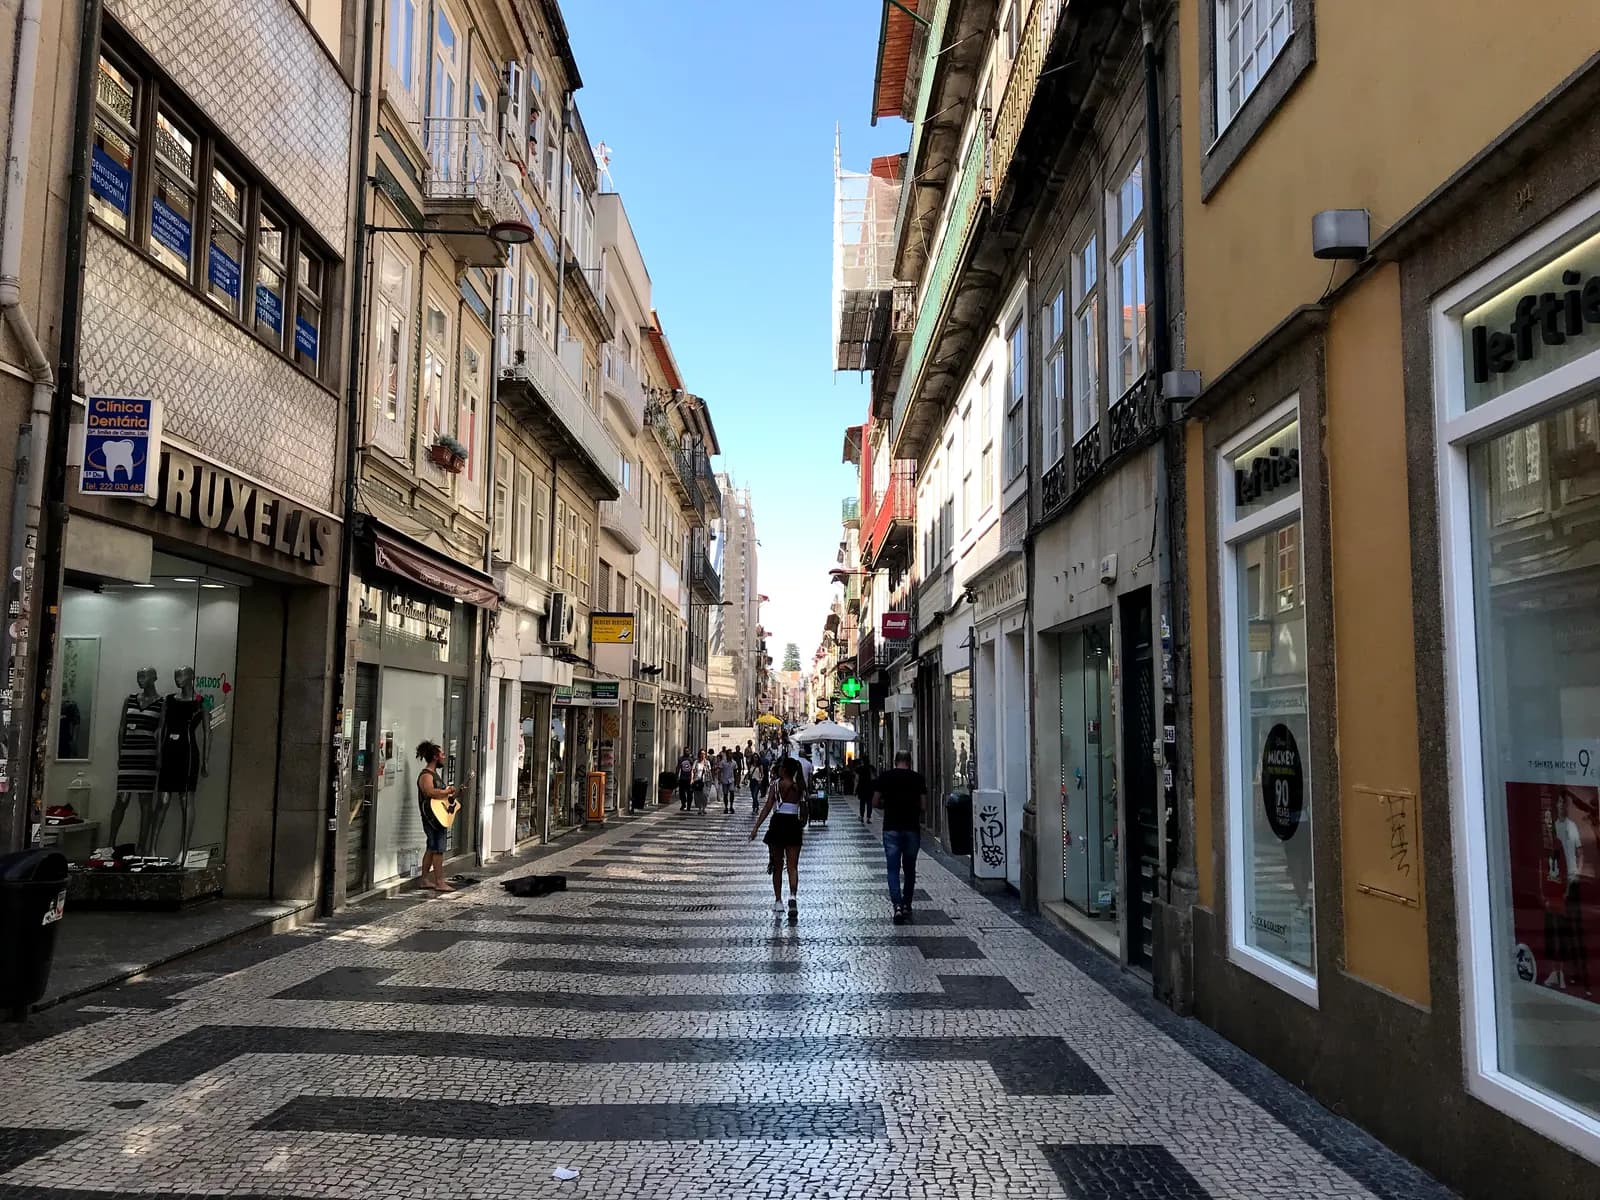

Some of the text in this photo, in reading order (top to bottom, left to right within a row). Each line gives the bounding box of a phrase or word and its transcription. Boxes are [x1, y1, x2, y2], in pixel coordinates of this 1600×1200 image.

[95, 400, 144, 413] Clínica
[89, 415, 148, 428] Dentária
[152, 450, 333, 567] RUXELAS
[195, 676, 221, 688] SALDOS
[1267, 749, 1296, 766] MICKEY
[1527, 760, 1553, 769] T-SHIRTS
[1554, 760, 1577, 769] MICKEY
[1275, 778, 1290, 808] 90
